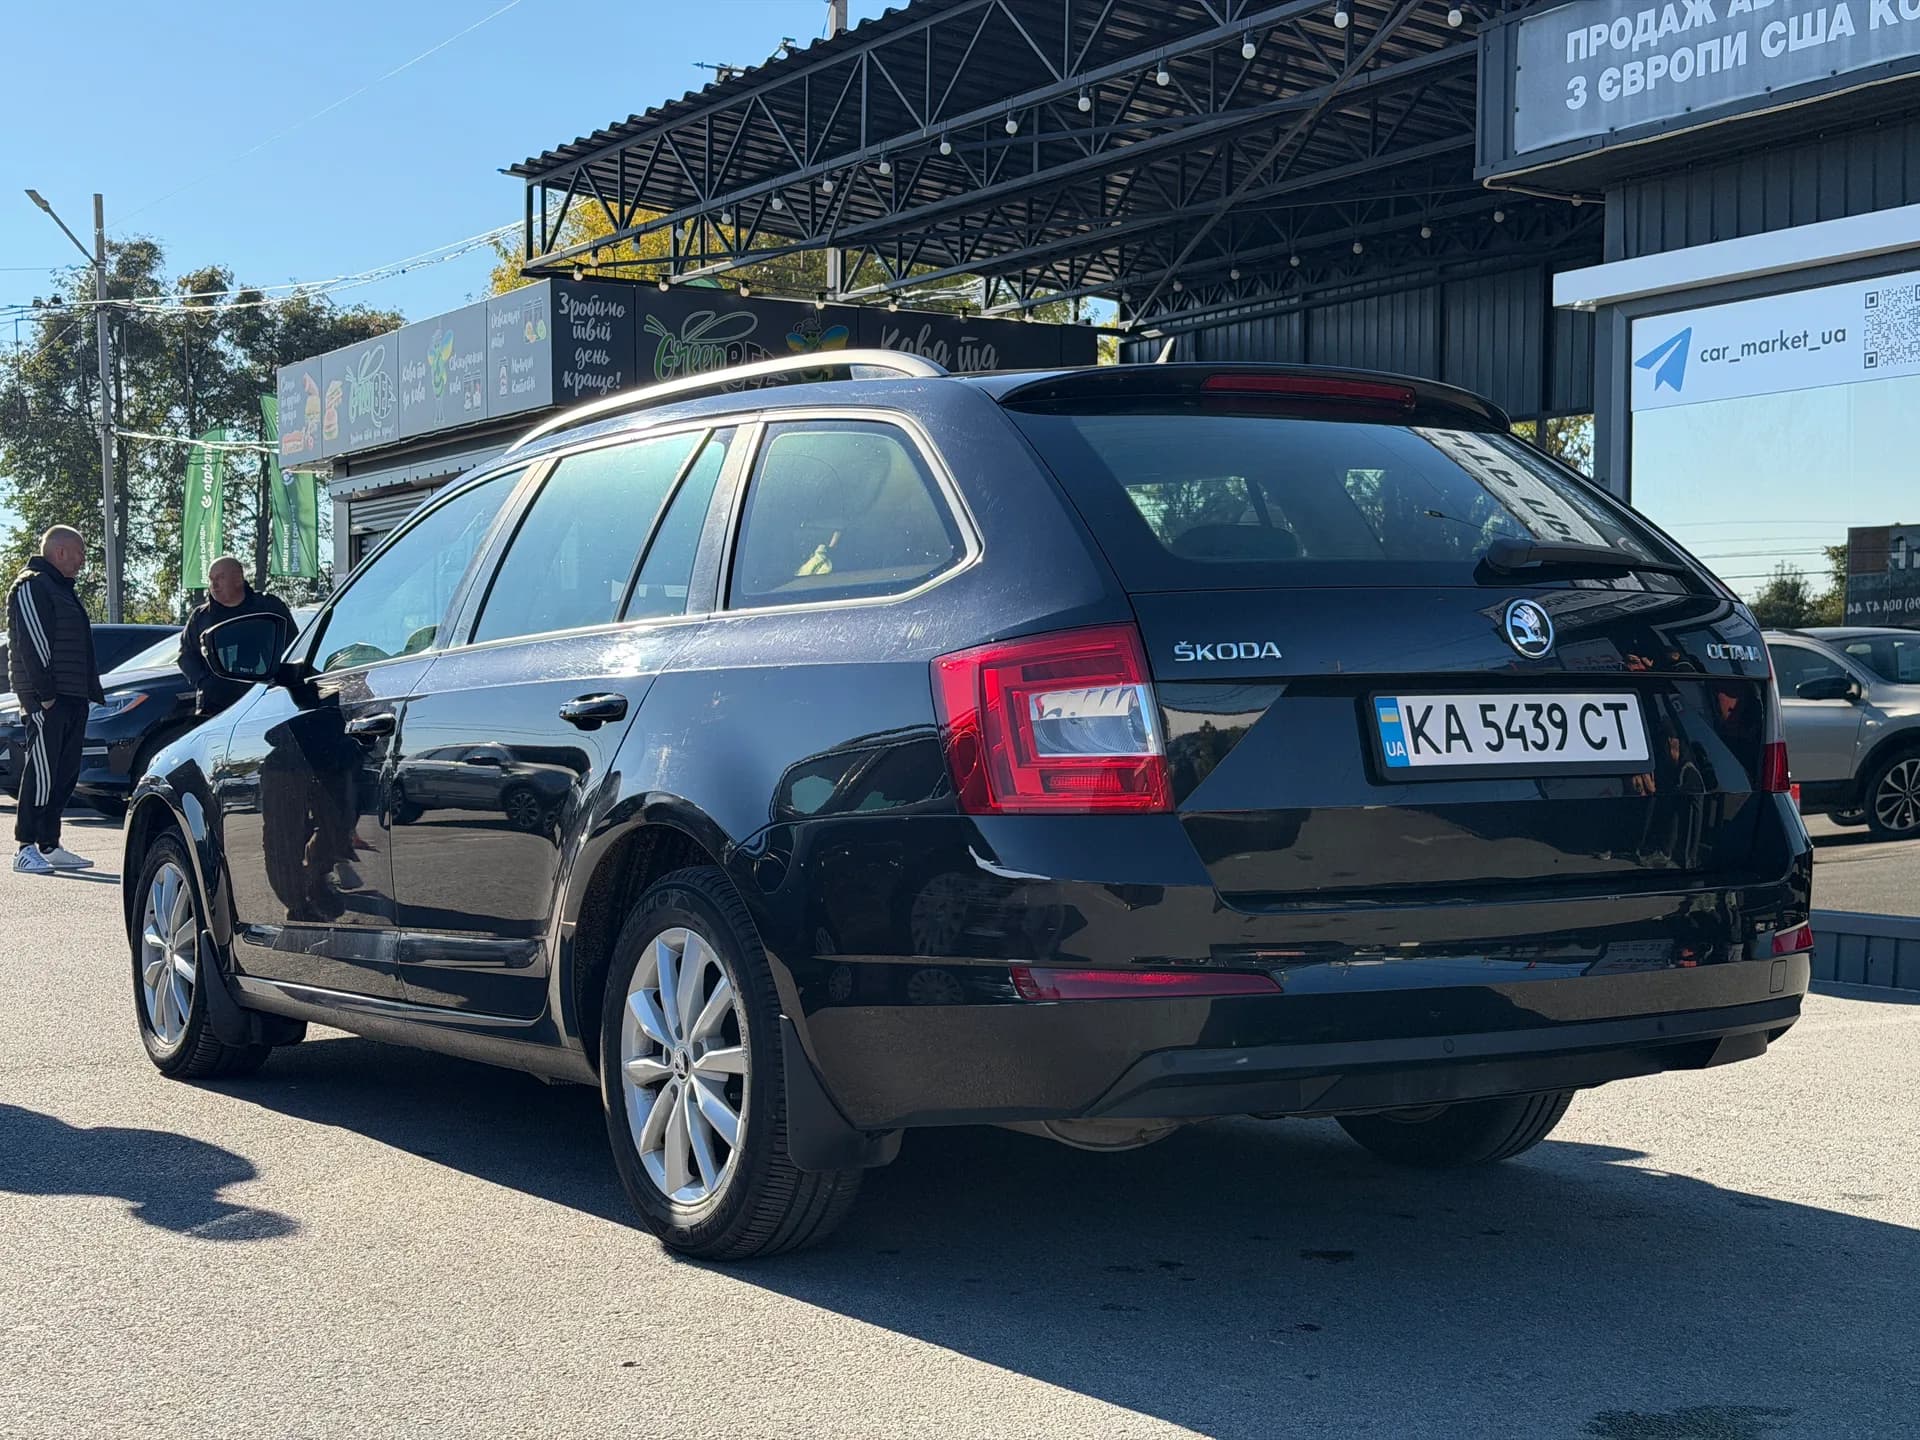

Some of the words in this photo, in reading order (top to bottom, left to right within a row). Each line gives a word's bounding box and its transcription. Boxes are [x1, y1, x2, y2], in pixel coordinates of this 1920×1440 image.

[1566, 0, 1716, 63] ПРОДАЖ
[1566, 75, 1588, 110] З
[1598, 30, 1748, 102] ЄВРОПИ
[1760, 2, 1856, 58] США
[558, 292, 626, 323] Зробимо
[572, 317, 612, 342] твій
[574, 346, 611, 370] день
[1700, 328, 1847, 363] car_market_ua
[562, 370, 622, 397] краще!
[1173, 640, 1282, 662] ŠKODA
[1405, 704, 1473, 755] KA
[1478, 703, 1568, 753] 5439
[1579, 703, 1628, 751] CT
[1385, 741, 1407, 757] UA
